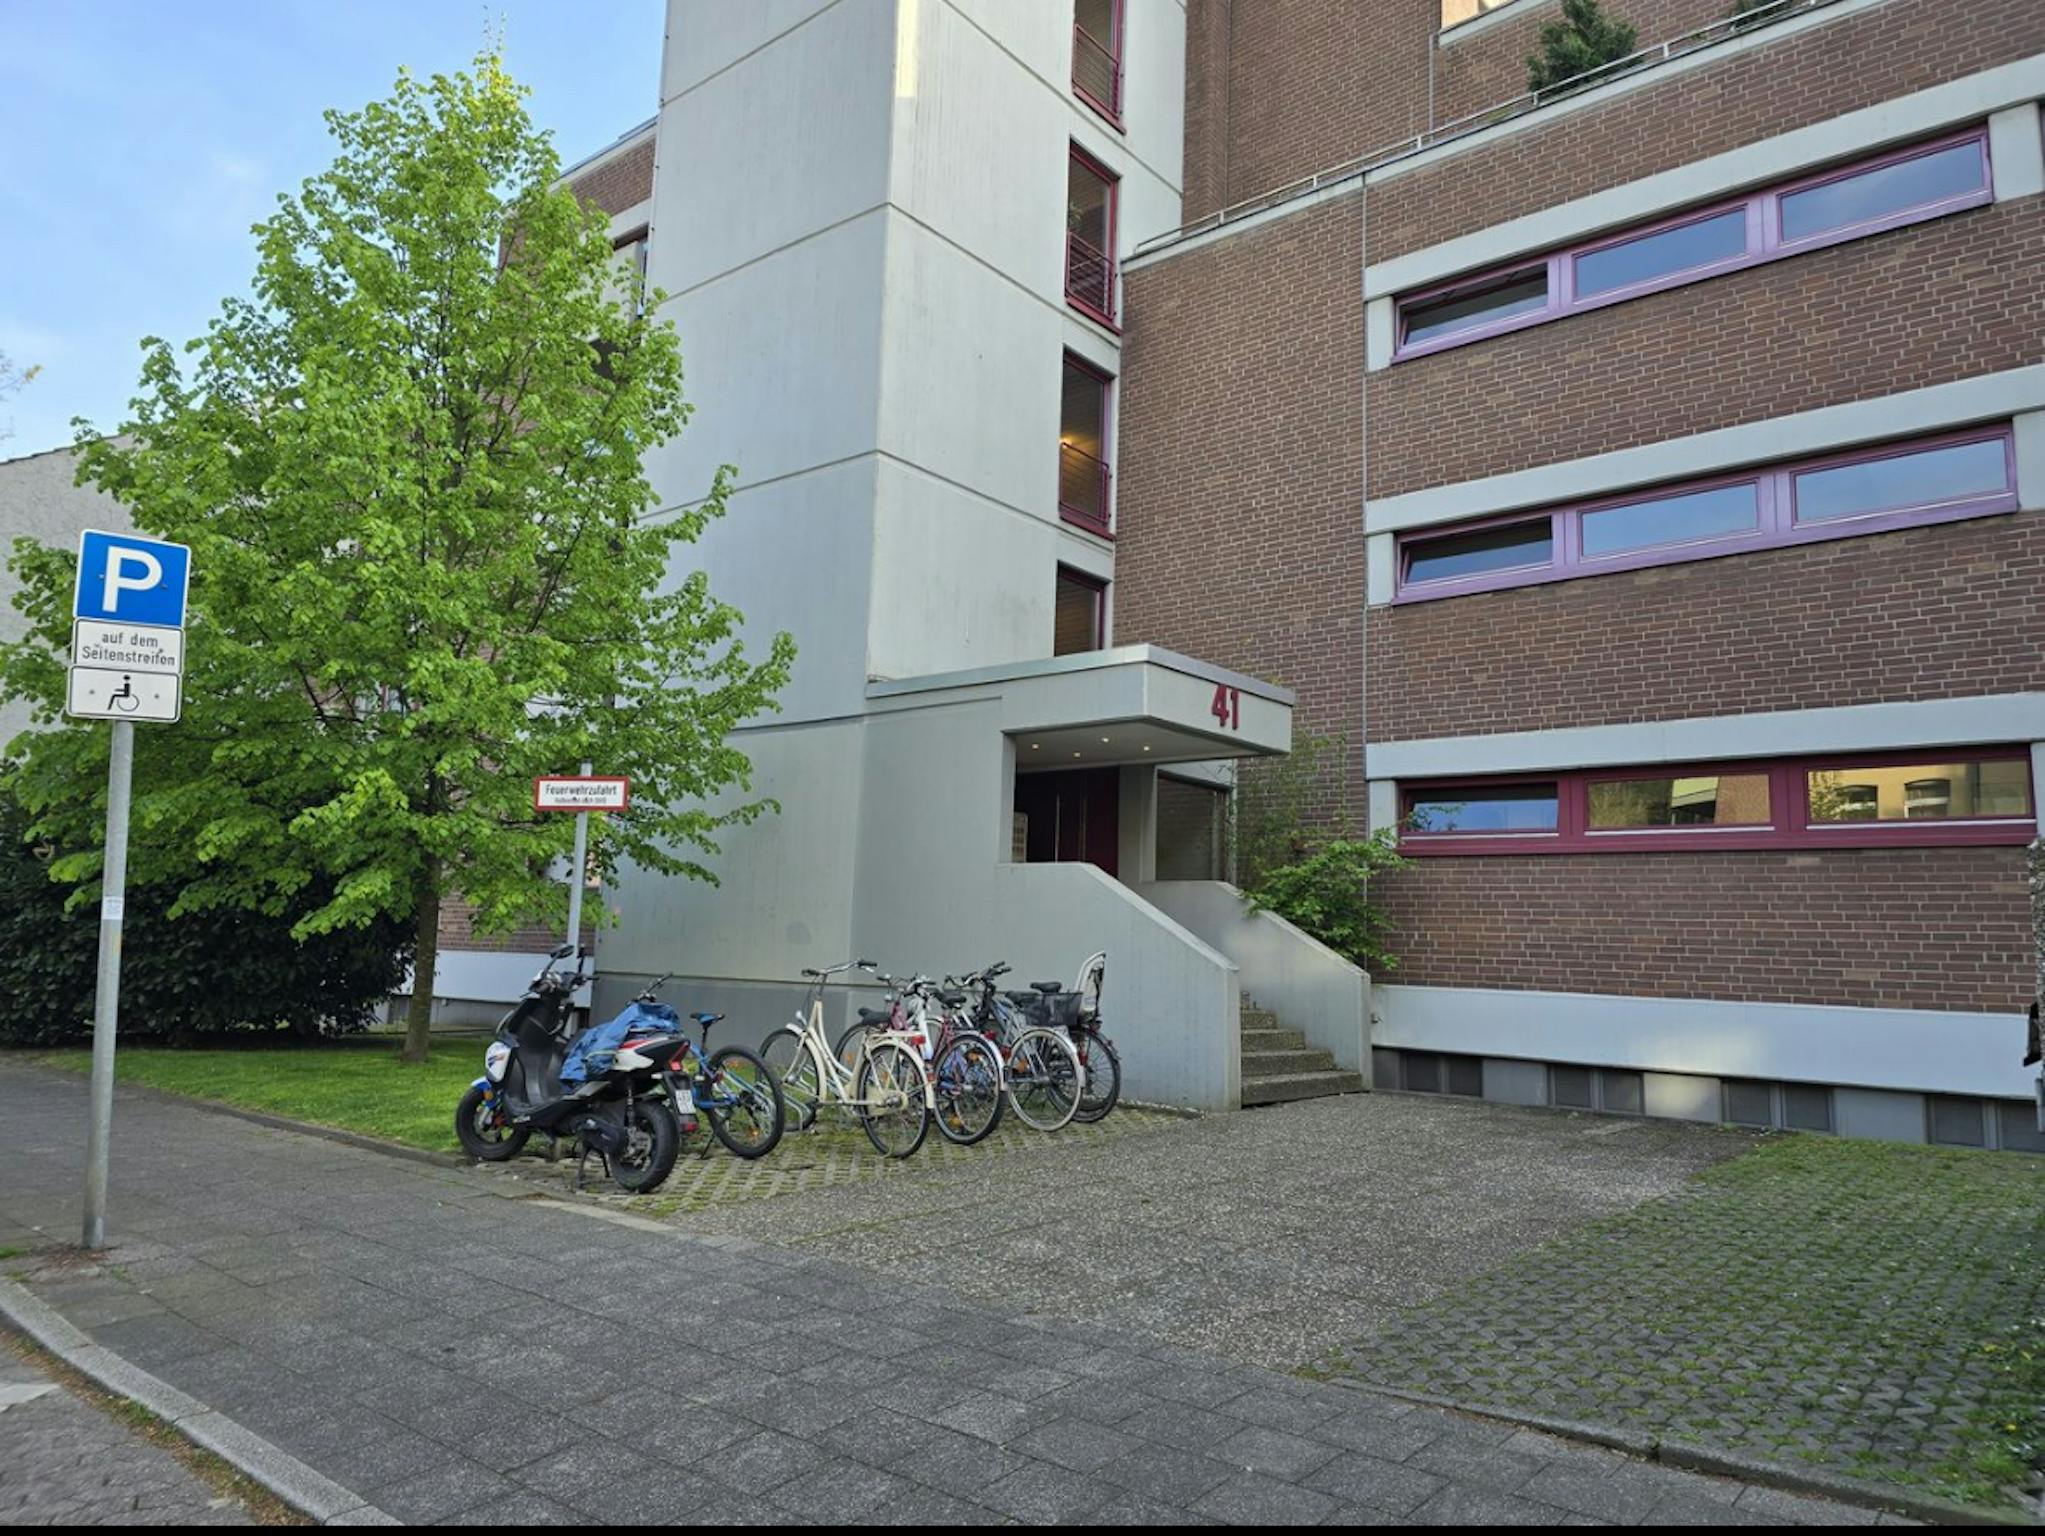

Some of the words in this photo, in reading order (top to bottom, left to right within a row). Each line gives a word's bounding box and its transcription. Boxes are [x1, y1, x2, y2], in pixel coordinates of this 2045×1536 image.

[102, 545, 163, 613] P
[102, 632, 123, 645] auf
[130, 633, 158, 648] dem
[82, 645, 175, 666] Seitenstreifen
[1211, 684, 1239, 730] 41
[545, 784, 617, 796] Feuerwehrzufahrt
